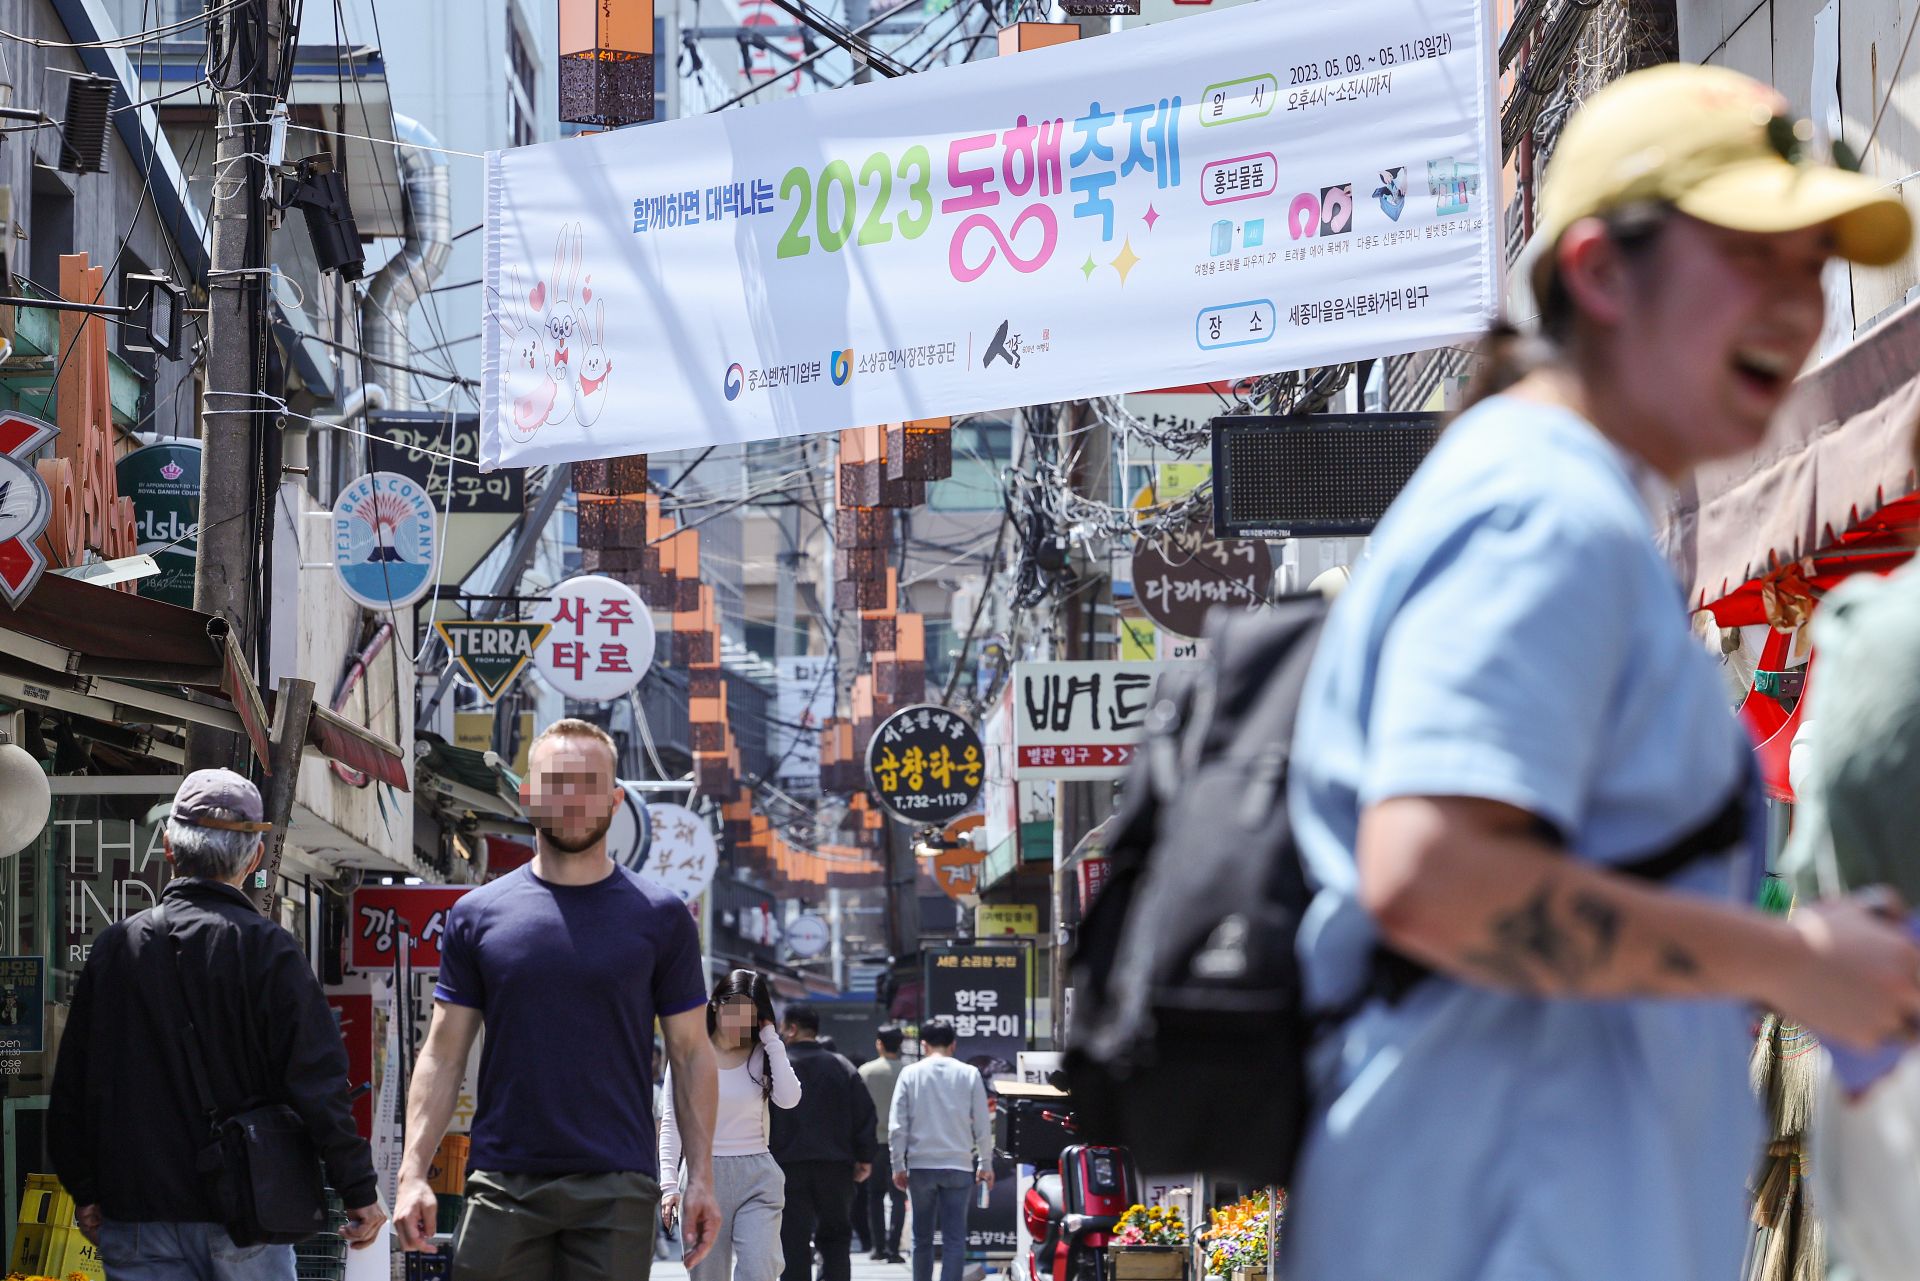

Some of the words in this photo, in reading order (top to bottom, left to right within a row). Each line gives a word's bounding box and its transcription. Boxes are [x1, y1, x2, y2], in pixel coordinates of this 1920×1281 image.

[1289, 63, 1321, 85] 2023.
[1325, 58, 1343, 78] 05.
[1345, 54, 1365, 73] 09.
[1379, 47, 1398, 67] 05.
[1287, 72, 1392, 111] 오후4시~소진시까지
[1214, 163, 1264, 195] 홍보물품
[633, 189, 700, 233] 함께하면
[705, 178, 774, 221] 대박나는
[776, 145, 933, 259] 2023
[1357, 235, 1380, 250] 다용도
[1383, 228, 1421, 247] 신발주머니
[1458, 219, 1471, 232] 4개
[1473, 219, 1483, 230] se
[1195, 262, 1216, 276] 여행용
[1218, 258, 1241, 272] 트래블
[1243, 253, 1265, 269] 파우치
[1267, 252, 1277, 264] 2P
[1284, 247, 1306, 261] 트래블
[1309, 243, 1324, 258] 에어
[1327, 239, 1350, 255] 목베개
[1288, 289, 1402, 327] 세종마을음식문화거리
[1405, 285, 1430, 309] 입구
[858, 341, 957, 374] 소상공인시장진흥공단
[748, 360, 822, 392] 중소벤처기업부
[342, 479, 382, 514] BEER
[136, 510, 199, 541] rlsbe
[388, 479, 432, 560] COMPANY
[338, 520, 350, 560] JEJU
[552, 597, 634, 636] 사주
[448, 628, 534, 659] TERRA
[552, 641, 633, 681] 타로
[874, 744, 982, 792] 곱창타운
[1027, 747, 1056, 765] 별관
[1061, 747, 1091, 764] 입구
[893, 792, 969, 809] T.732-1179
[53, 818, 168, 874] THA
[360, 907, 395, 952] 깡
[955, 989, 998, 1013] 한우
